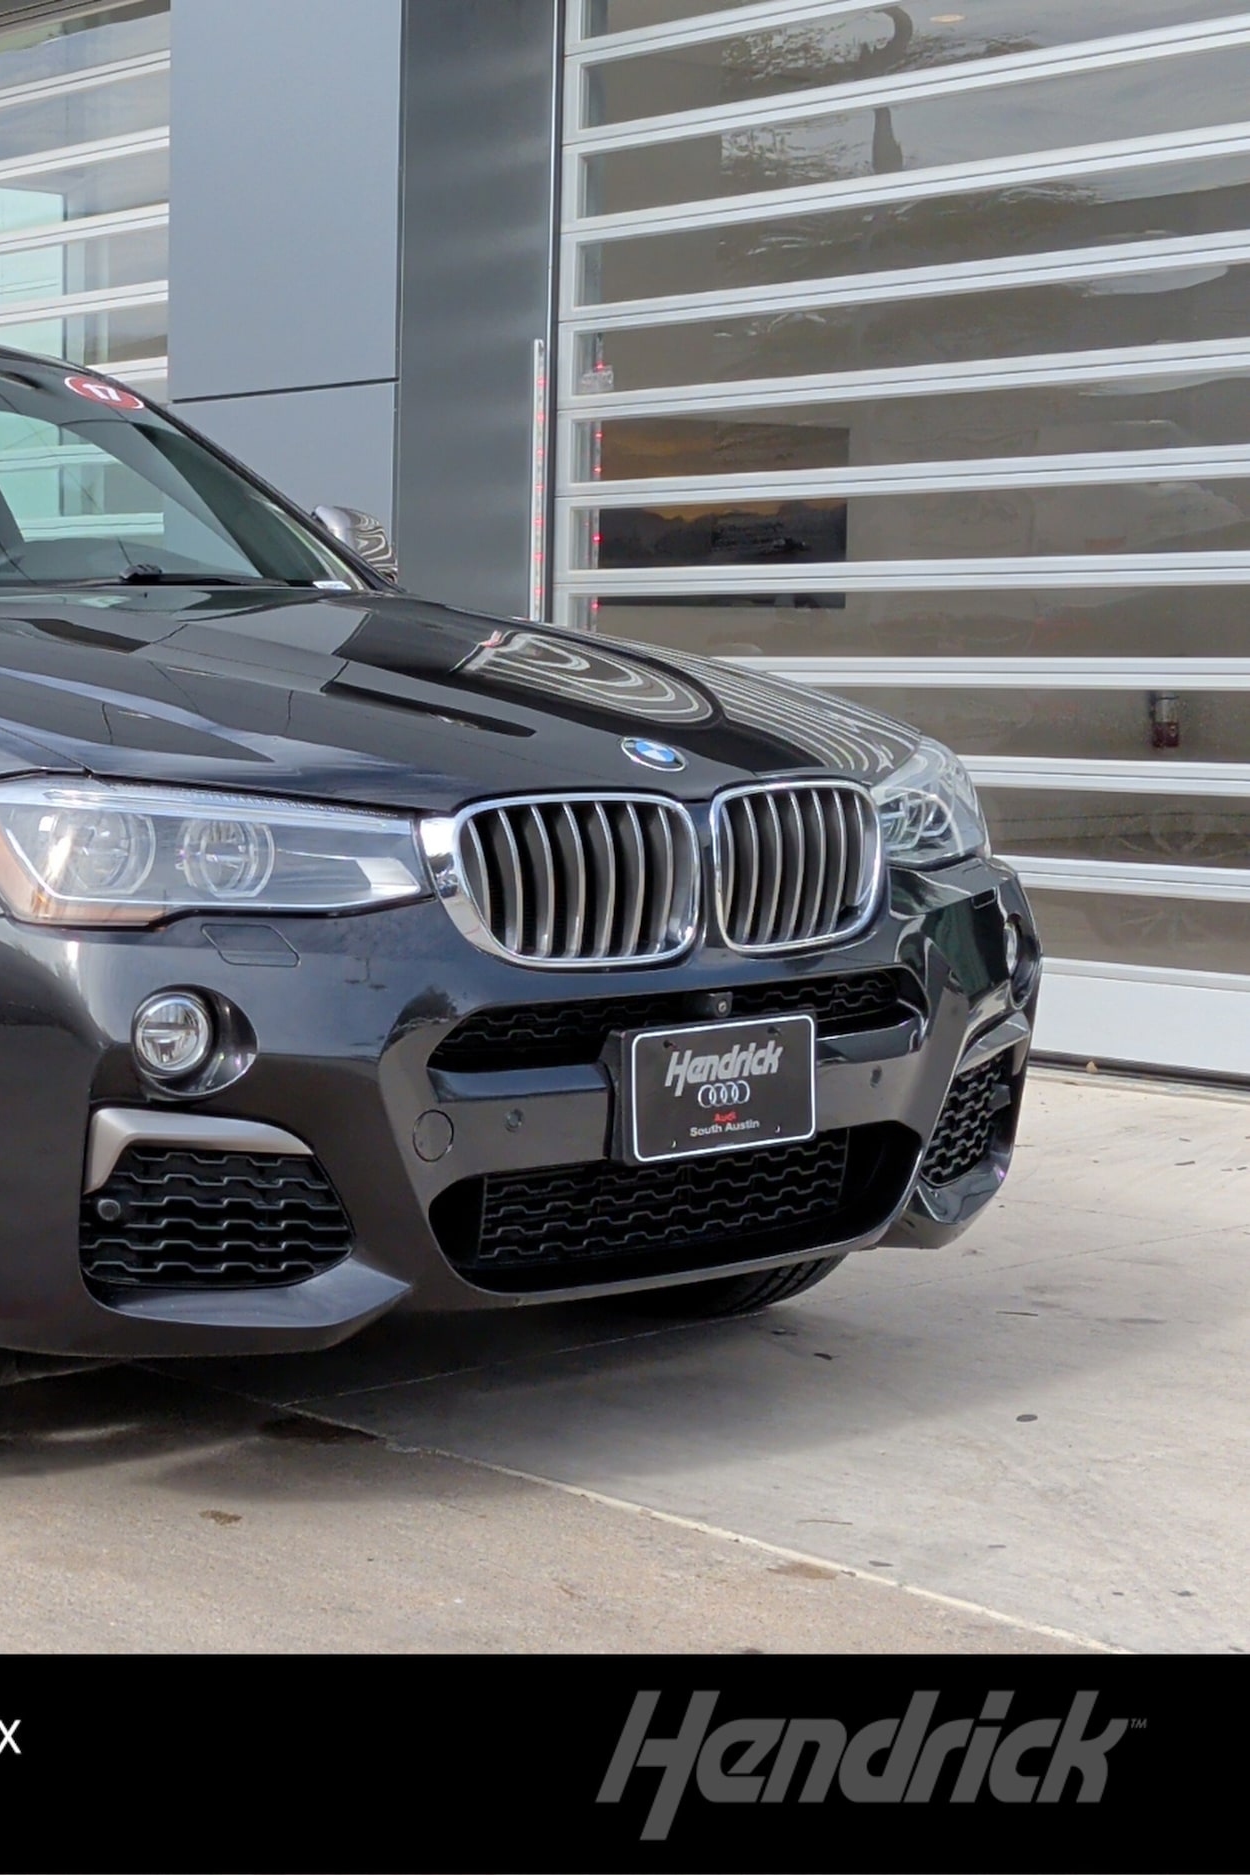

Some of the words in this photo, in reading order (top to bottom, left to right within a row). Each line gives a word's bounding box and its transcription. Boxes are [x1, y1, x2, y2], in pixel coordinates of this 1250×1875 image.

[82, 383, 122, 402] 17
[664, 1040, 784, 1097] Hendrick
[714, 1111, 738, 1122] Audi
[690, 1123, 722, 1137] South
[724, 1119, 760, 1132] Austin
